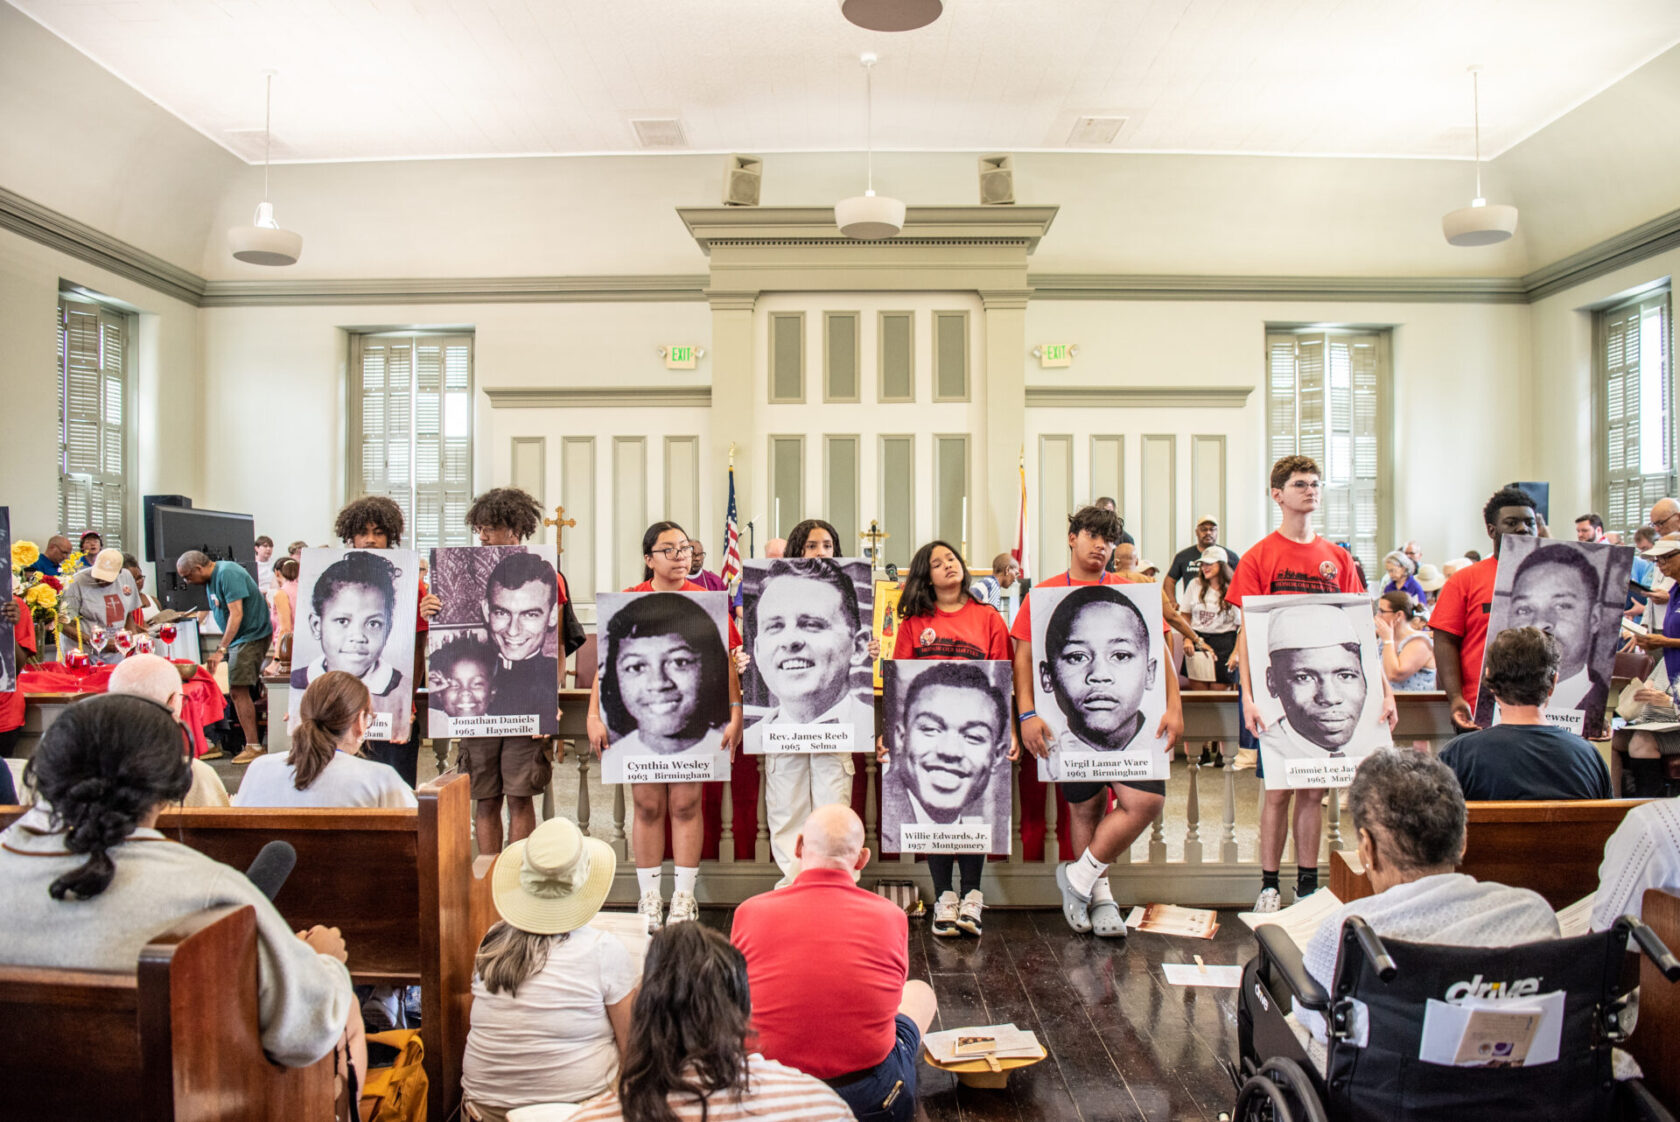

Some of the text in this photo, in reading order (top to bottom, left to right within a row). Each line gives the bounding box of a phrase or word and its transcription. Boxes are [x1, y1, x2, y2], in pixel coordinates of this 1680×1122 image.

[672, 347, 691, 361] EXIT
[1047, 345, 1065, 360] EXIT
[452, 715, 535, 725] Jonathan Daniels
[1545, 714, 1581, 722] ewster
[486, 725, 534, 735] Hayneville
[769, 733, 790, 741] Rev.
[825, 732, 848, 740] Reeb
[810, 742, 837, 750] Selma
[627, 760, 710, 771] Cynthia Wesley
[1064, 760, 1089, 768] Virgil
[655, 772, 710, 780] Birmingham
[1092, 769, 1147, 777] Birmingham
[1331, 774, 1352, 782] Mari
[904, 832, 931, 840] Willie
[933, 832, 974, 840] Edwards,
[932, 842, 984, 850] Montgomery
[1445, 974, 1540, 1005] drive
[1254, 983, 1269, 1011] drive
